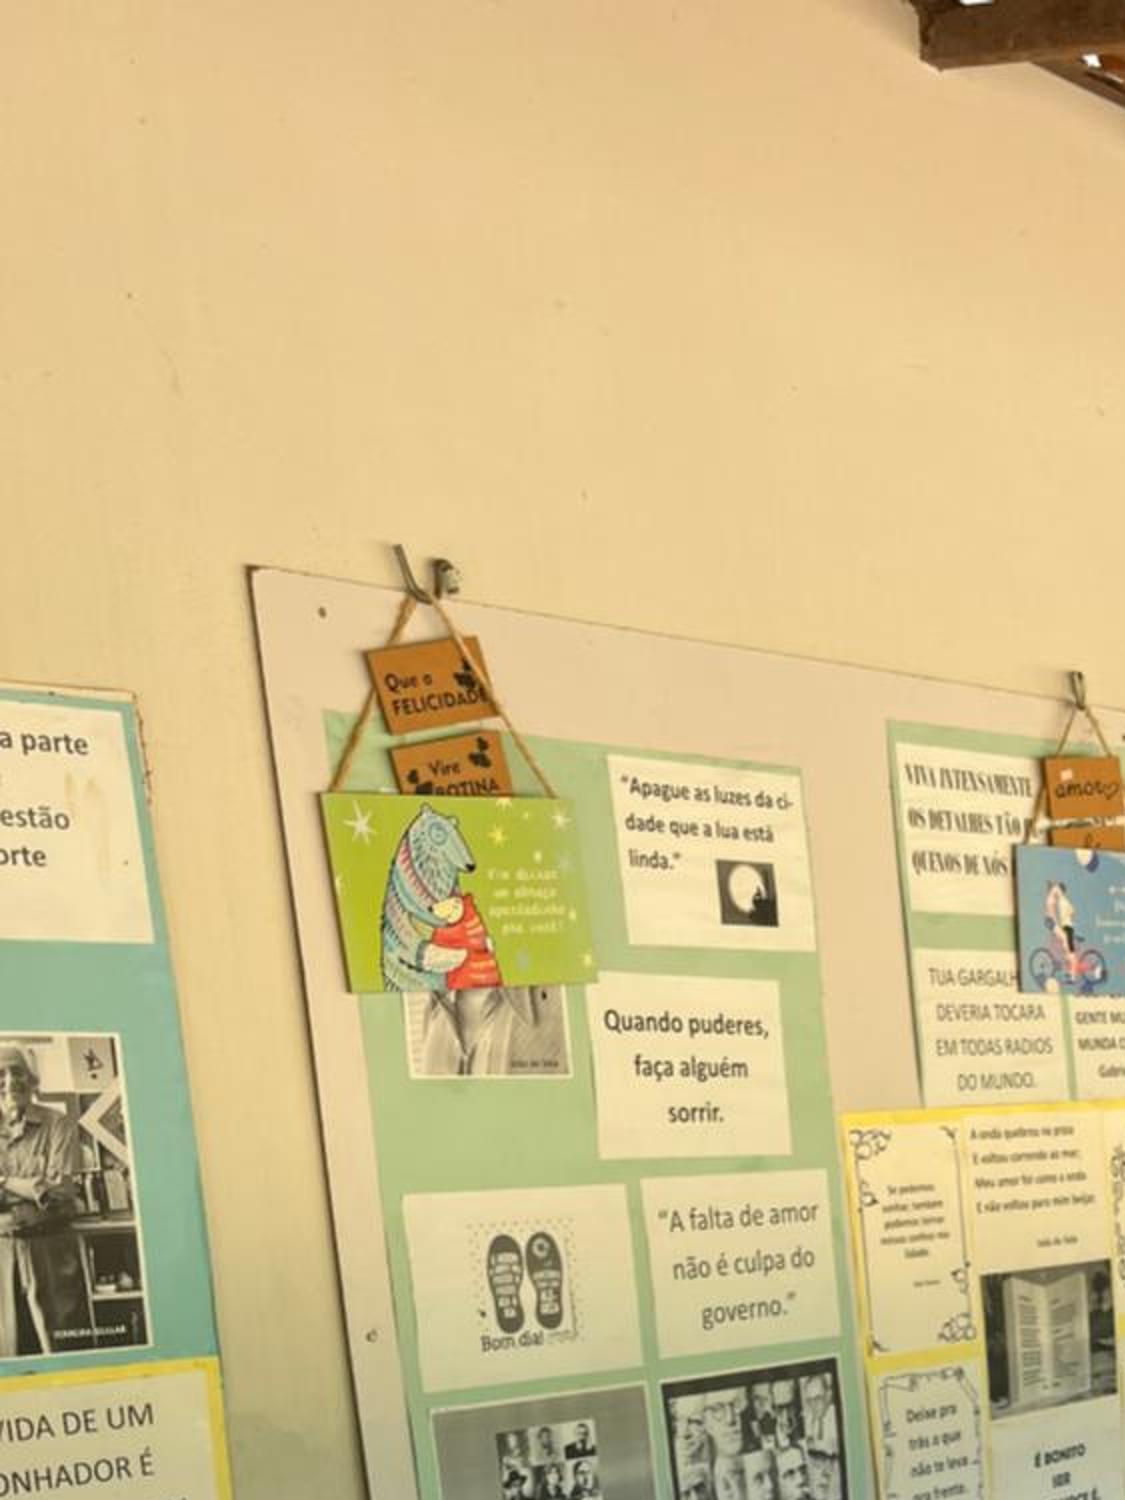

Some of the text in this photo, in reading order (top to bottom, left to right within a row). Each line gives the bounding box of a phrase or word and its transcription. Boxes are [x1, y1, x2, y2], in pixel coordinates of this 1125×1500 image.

[385, 673, 417, 692] Que
[21, 733, 89, 756] parte
[905, 763, 1033, 798] VIVA INTENSAMENTE
[693, 787, 712, 803] as
[714, 786, 753, 808] luzes
[755, 791, 775, 809] da
[1, 805, 70, 831] estão
[625, 813, 775, 843] dade que a lua está
[908, 807, 926, 828] OS
[928, 809, 993, 834] DETALHES
[928, 967, 956, 987] TUA
[603, 1009, 770, 1039] Quando puderes,
[936, 1004, 991, 1021] DEVERIA
[936, 1038, 957, 1056] EM
[960, 1037, 1002, 1056] TODAS
[634, 1053, 749, 1083] faça alguém
[958, 1073, 977, 1091] DO
[668, 1100, 725, 1124] sorrir.
[689, 1206, 735, 1231] falta
[740, 1203, 764, 1226] de
[768, 1203, 819, 1225] amor
[672, 1246, 816, 1281] não é culpa do
[481, 1334, 516, 1353] Bom
[518, 1330, 545, 1347] dia!
[62, 1410, 98, 1436] DE
[106, 1402, 154, 1431] UM
[906, 1406, 937, 1424] Deixe
[140, 1446, 156, 1477] É
[1044, 1443, 1087, 1466] BONITO
